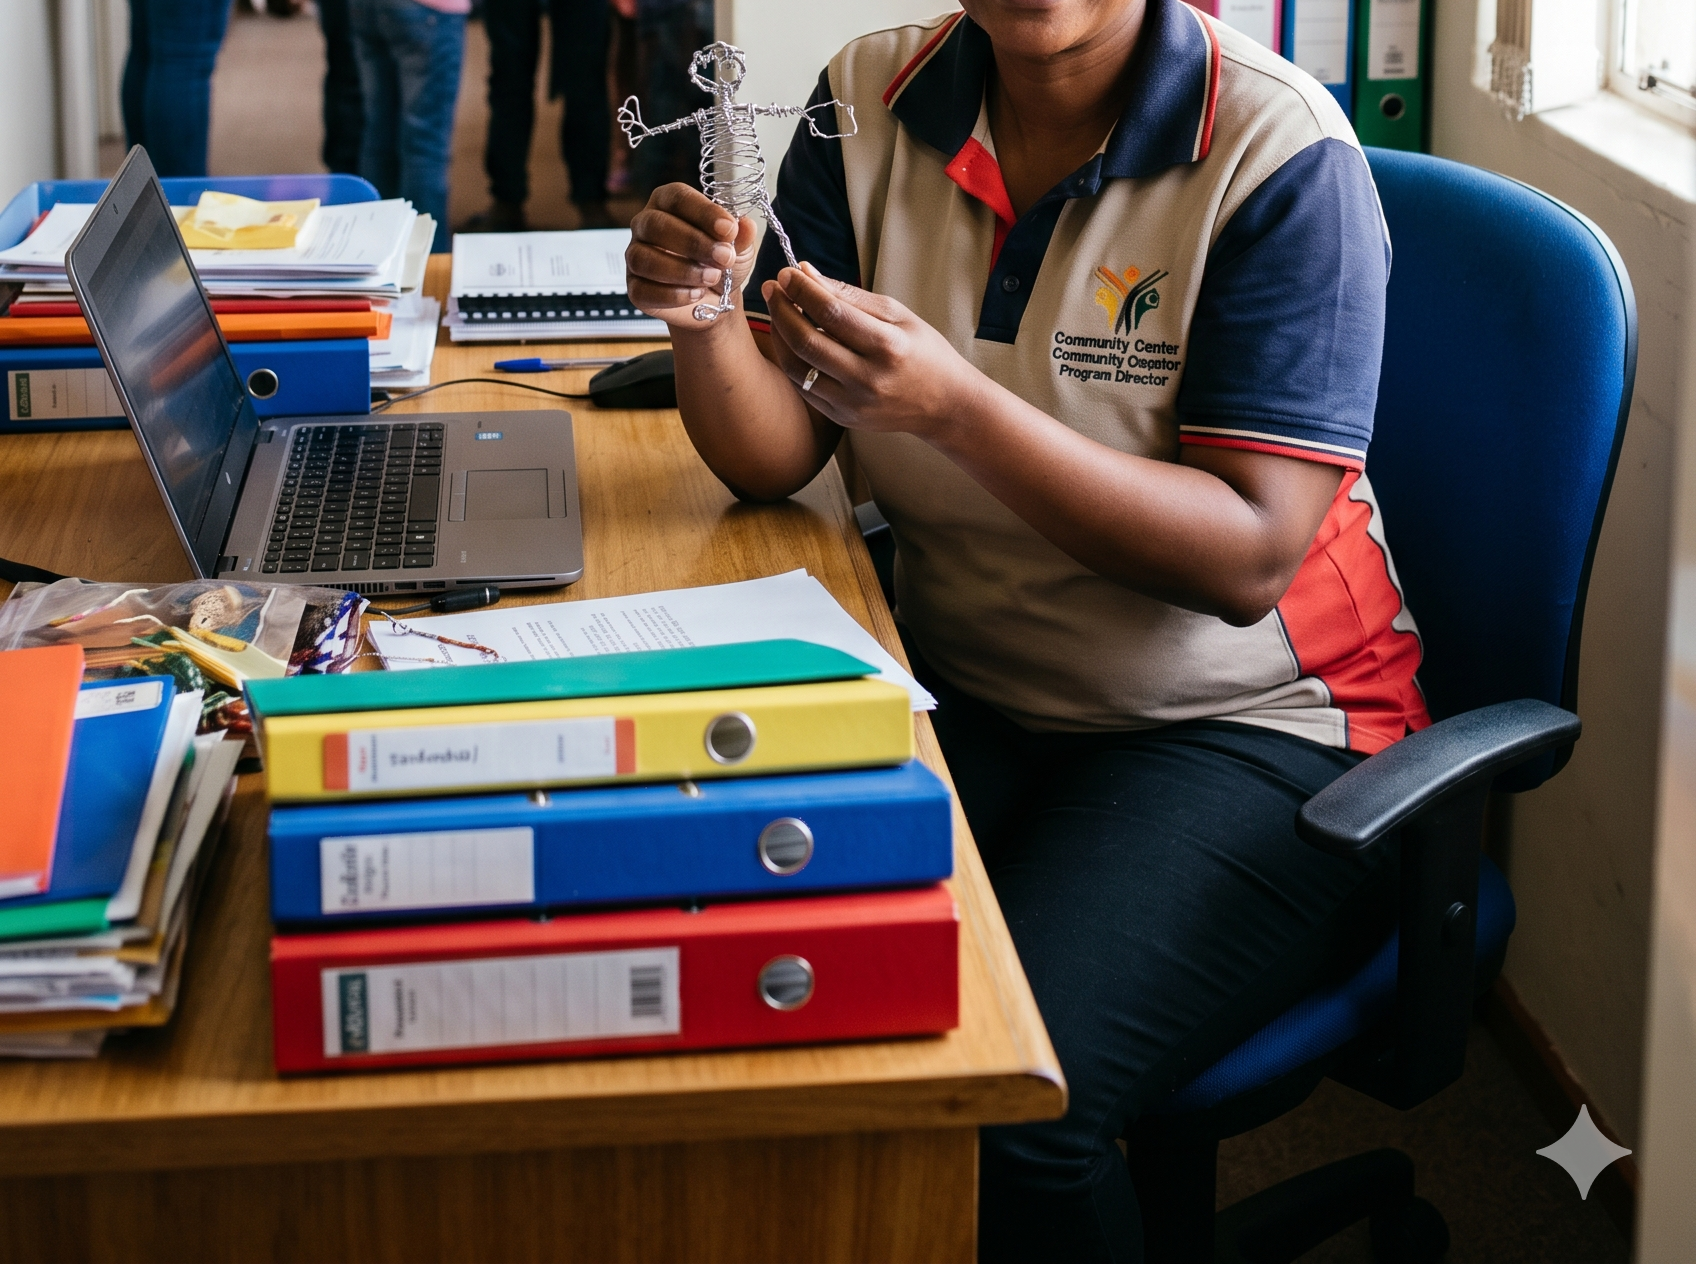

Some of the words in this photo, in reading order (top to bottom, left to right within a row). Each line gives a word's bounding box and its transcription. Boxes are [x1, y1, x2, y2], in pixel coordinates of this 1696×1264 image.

[1054, 331, 1130, 354] Community
[1134, 339, 1180, 355] Center
[1052, 347, 1124, 369] Community
[1059, 364, 1112, 382] Program
[1114, 370, 1169, 386] Director
